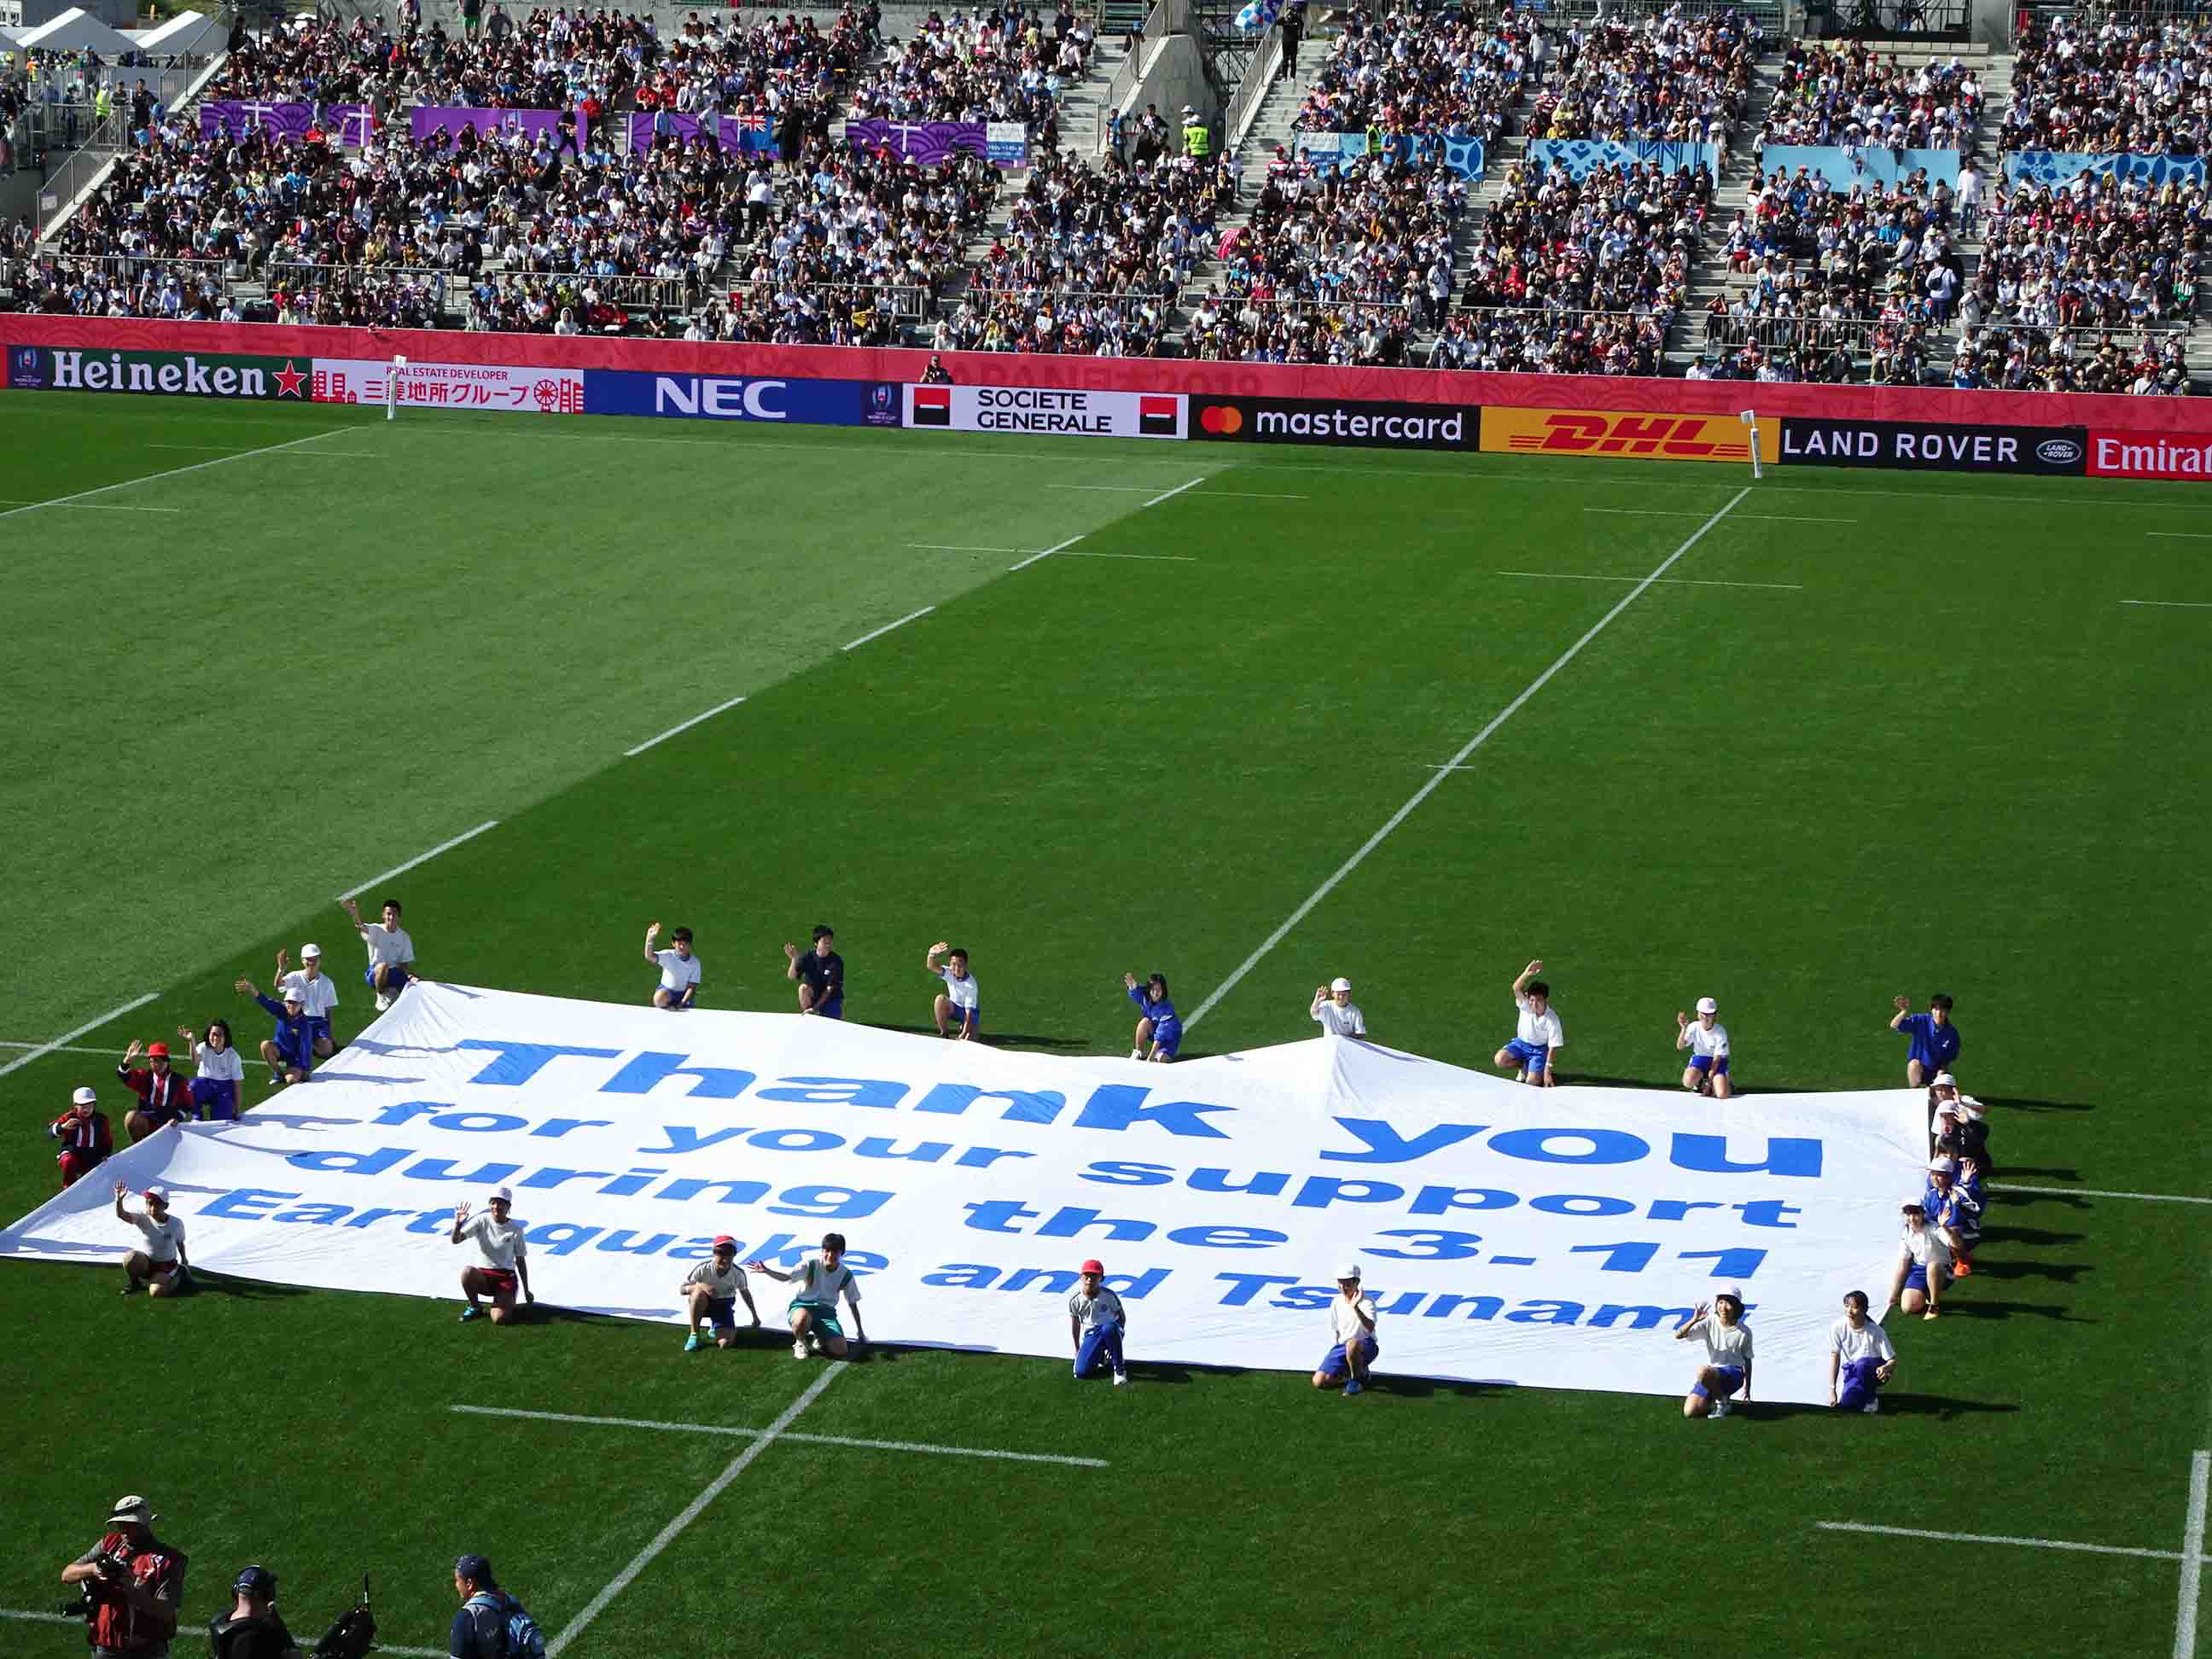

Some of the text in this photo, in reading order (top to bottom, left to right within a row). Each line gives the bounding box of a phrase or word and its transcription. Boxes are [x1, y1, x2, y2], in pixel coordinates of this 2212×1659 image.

[52, 351, 267, 397] Heineken
[413, 368, 448, 378] ESTATE
[450, 369, 509, 381] DEVELOPER
[655, 377, 787, 418] NEC
[977, 389, 1087, 410] SOCIETE
[976, 410, 1113, 434] GENERALE
[1256, 409, 1463, 441] mastercard
[1540, 415, 1717, 456] DHL
[1784, 428, 2018, 463] LAND ROVER
[456, 1039, 1824, 1179] Thank you
[370, 1101, 1802, 1229] for your support
[286, 1147, 895, 1219] during
[963, 1201, 1289, 1249] the
[195, 1188, 889, 1277] Eartquake
[920, 1264, 1173, 1299] and
